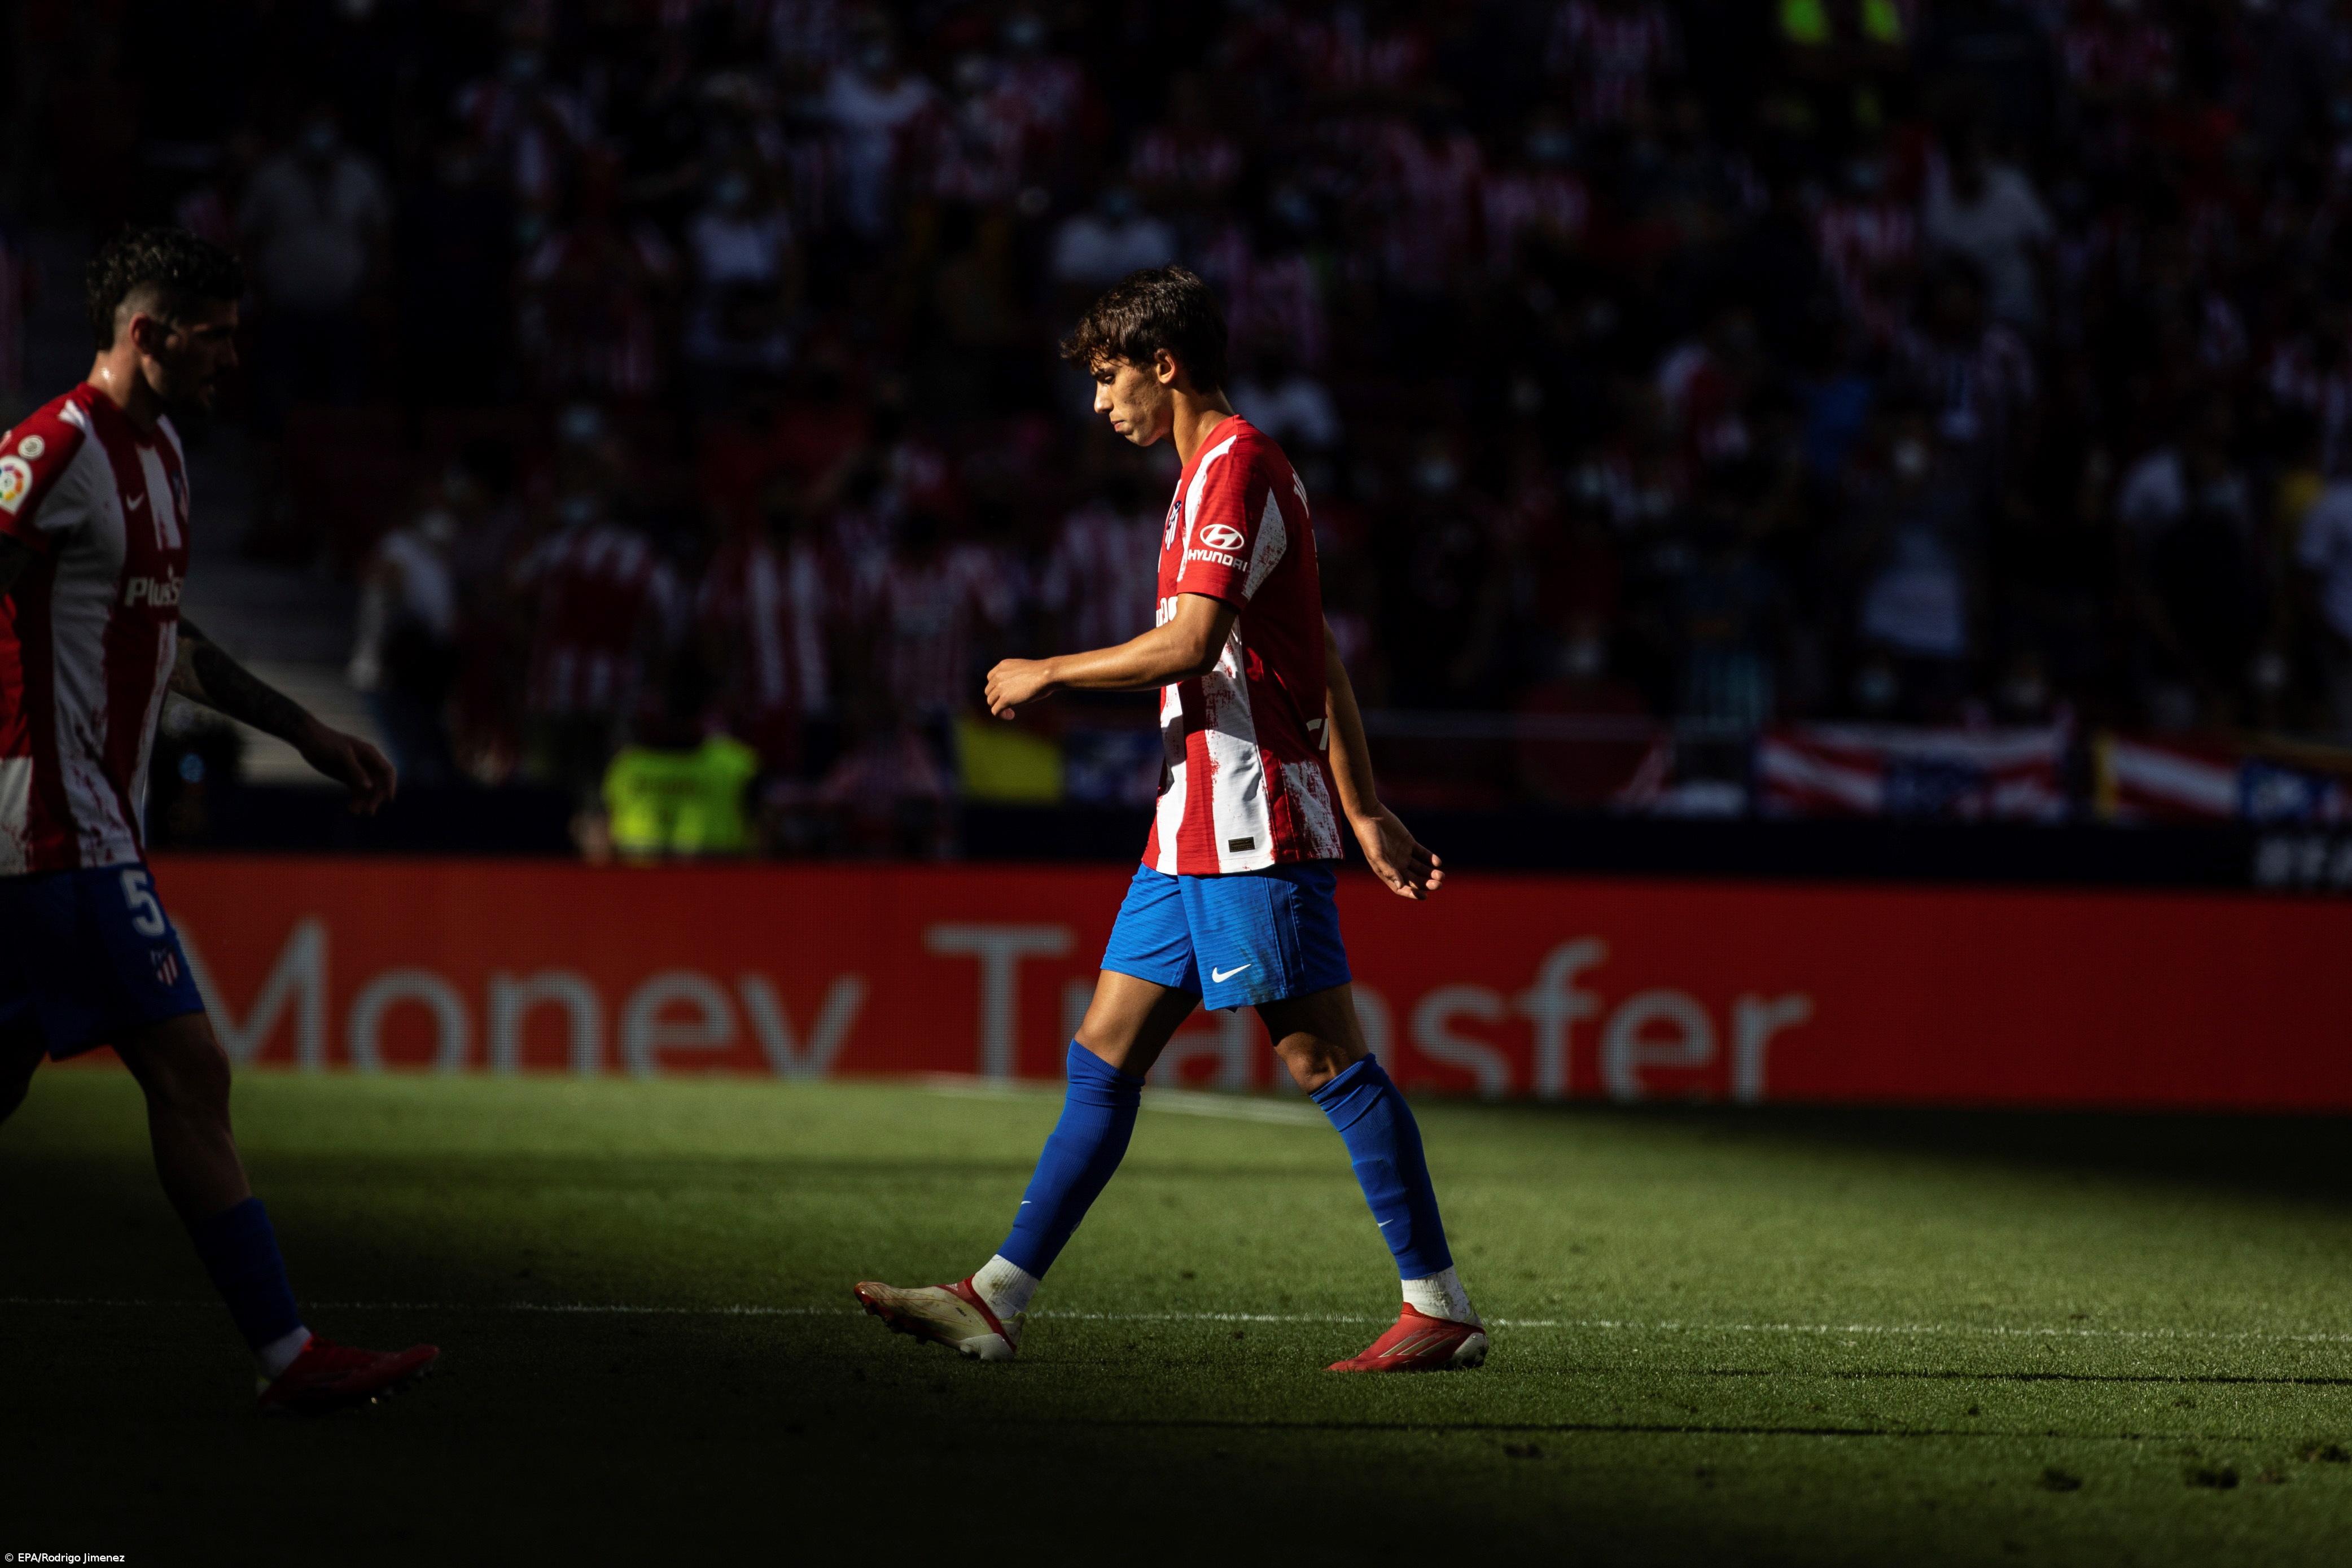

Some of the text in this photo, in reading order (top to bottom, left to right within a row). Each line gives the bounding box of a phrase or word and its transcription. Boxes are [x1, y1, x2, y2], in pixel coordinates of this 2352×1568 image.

[1188, 549, 1248, 572] HYUNDAI
[119, 868, 165, 937] 5
[168, 911, 873, 1080] Money
